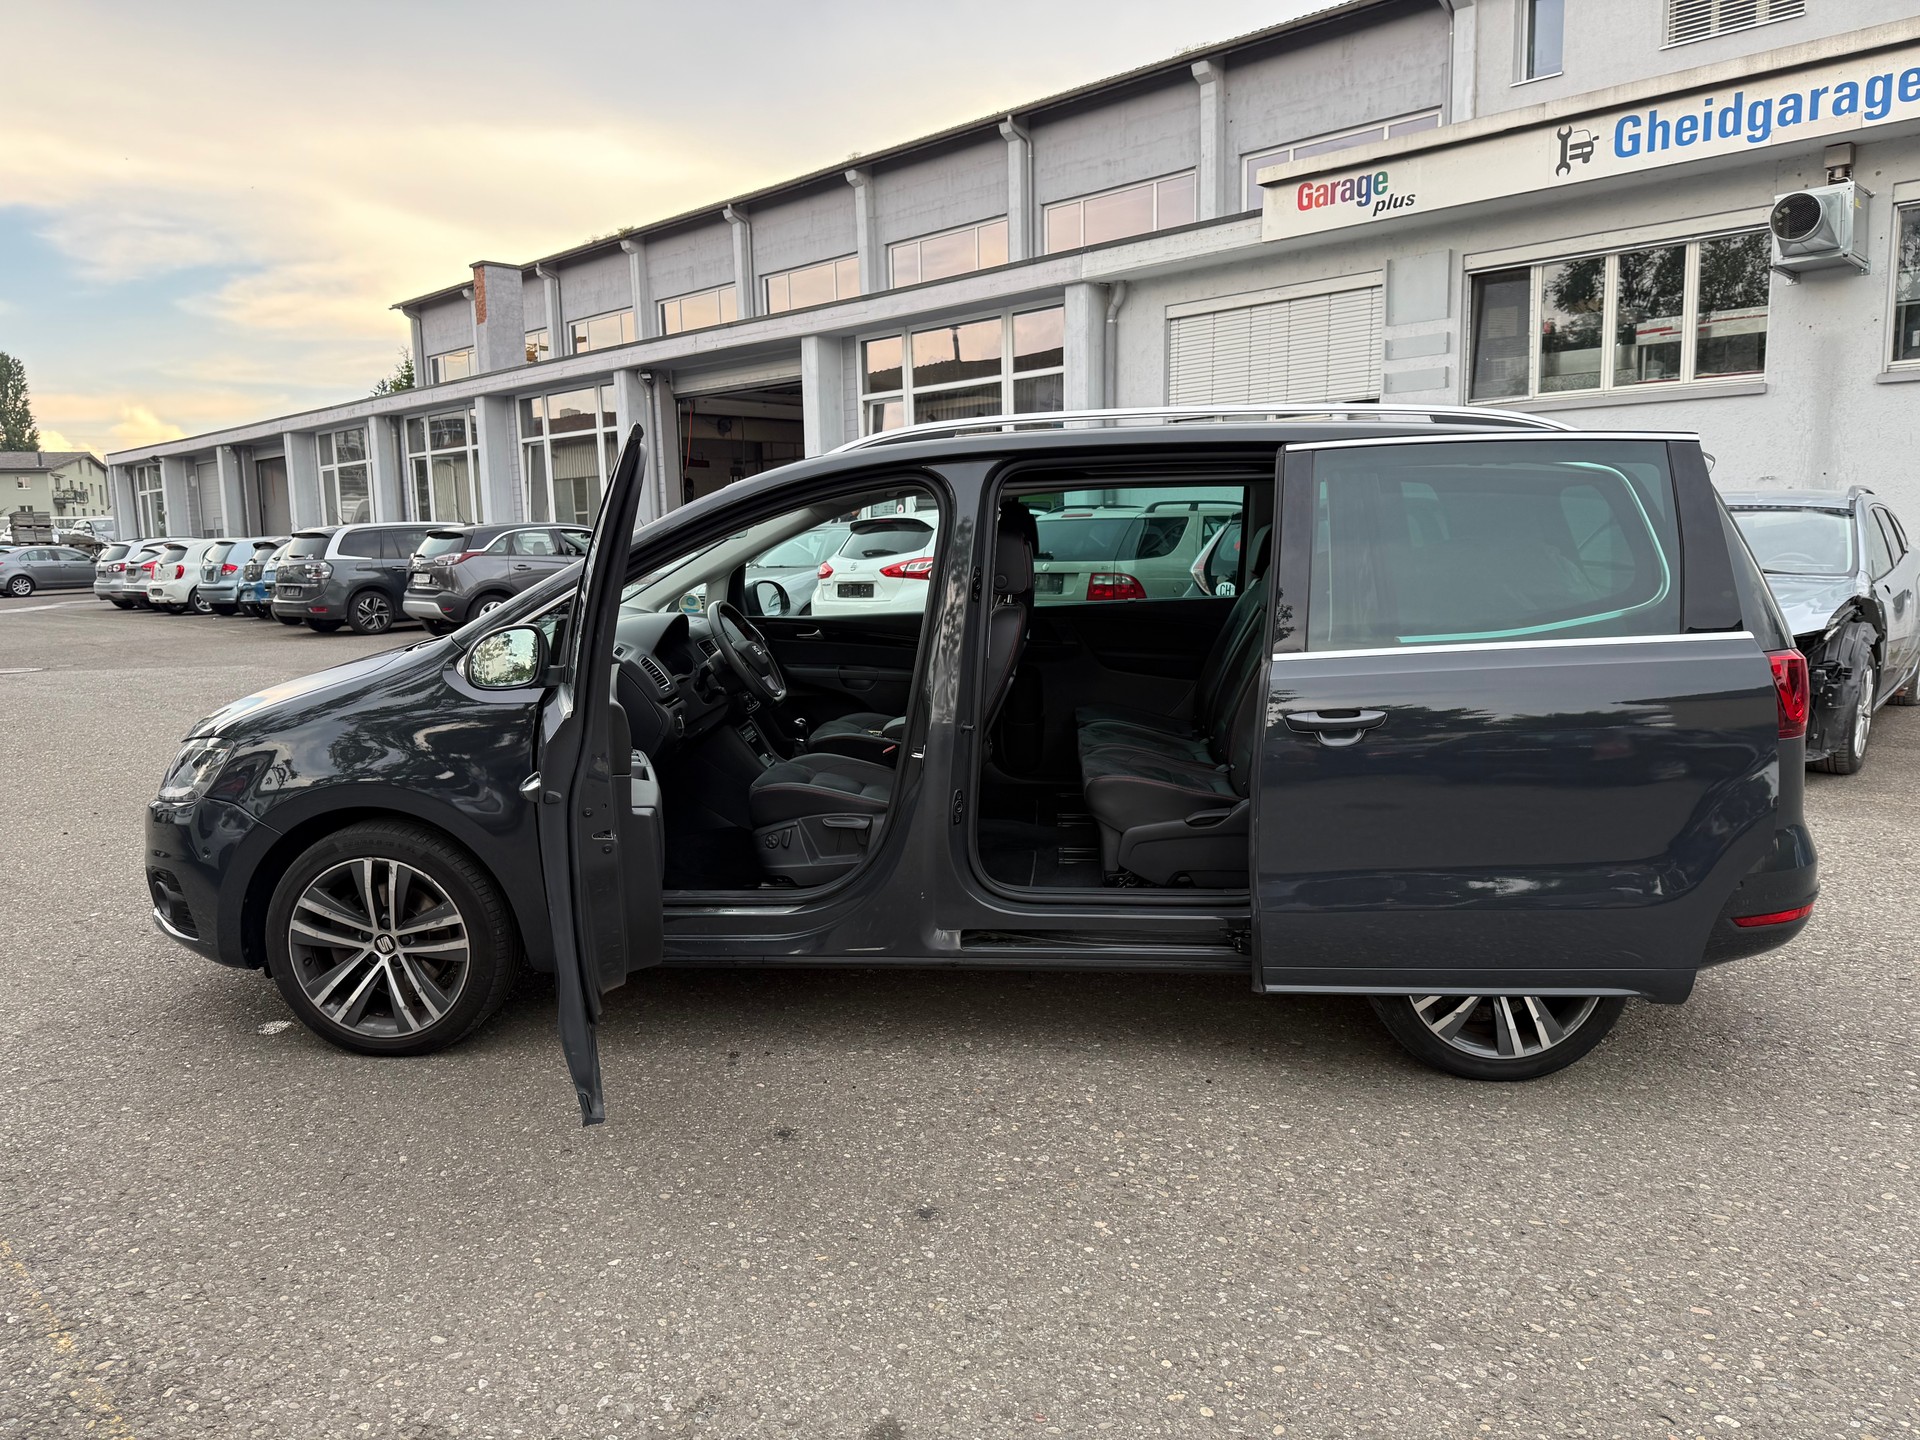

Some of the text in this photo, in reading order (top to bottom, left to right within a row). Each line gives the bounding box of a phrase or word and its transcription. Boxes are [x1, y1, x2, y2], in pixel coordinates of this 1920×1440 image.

[1614, 67, 1920, 158] Gheidgarage
[1297, 171, 1389, 211] Garage
[1372, 193, 1416, 217] plus
[1220, 584, 1232, 596] CH
